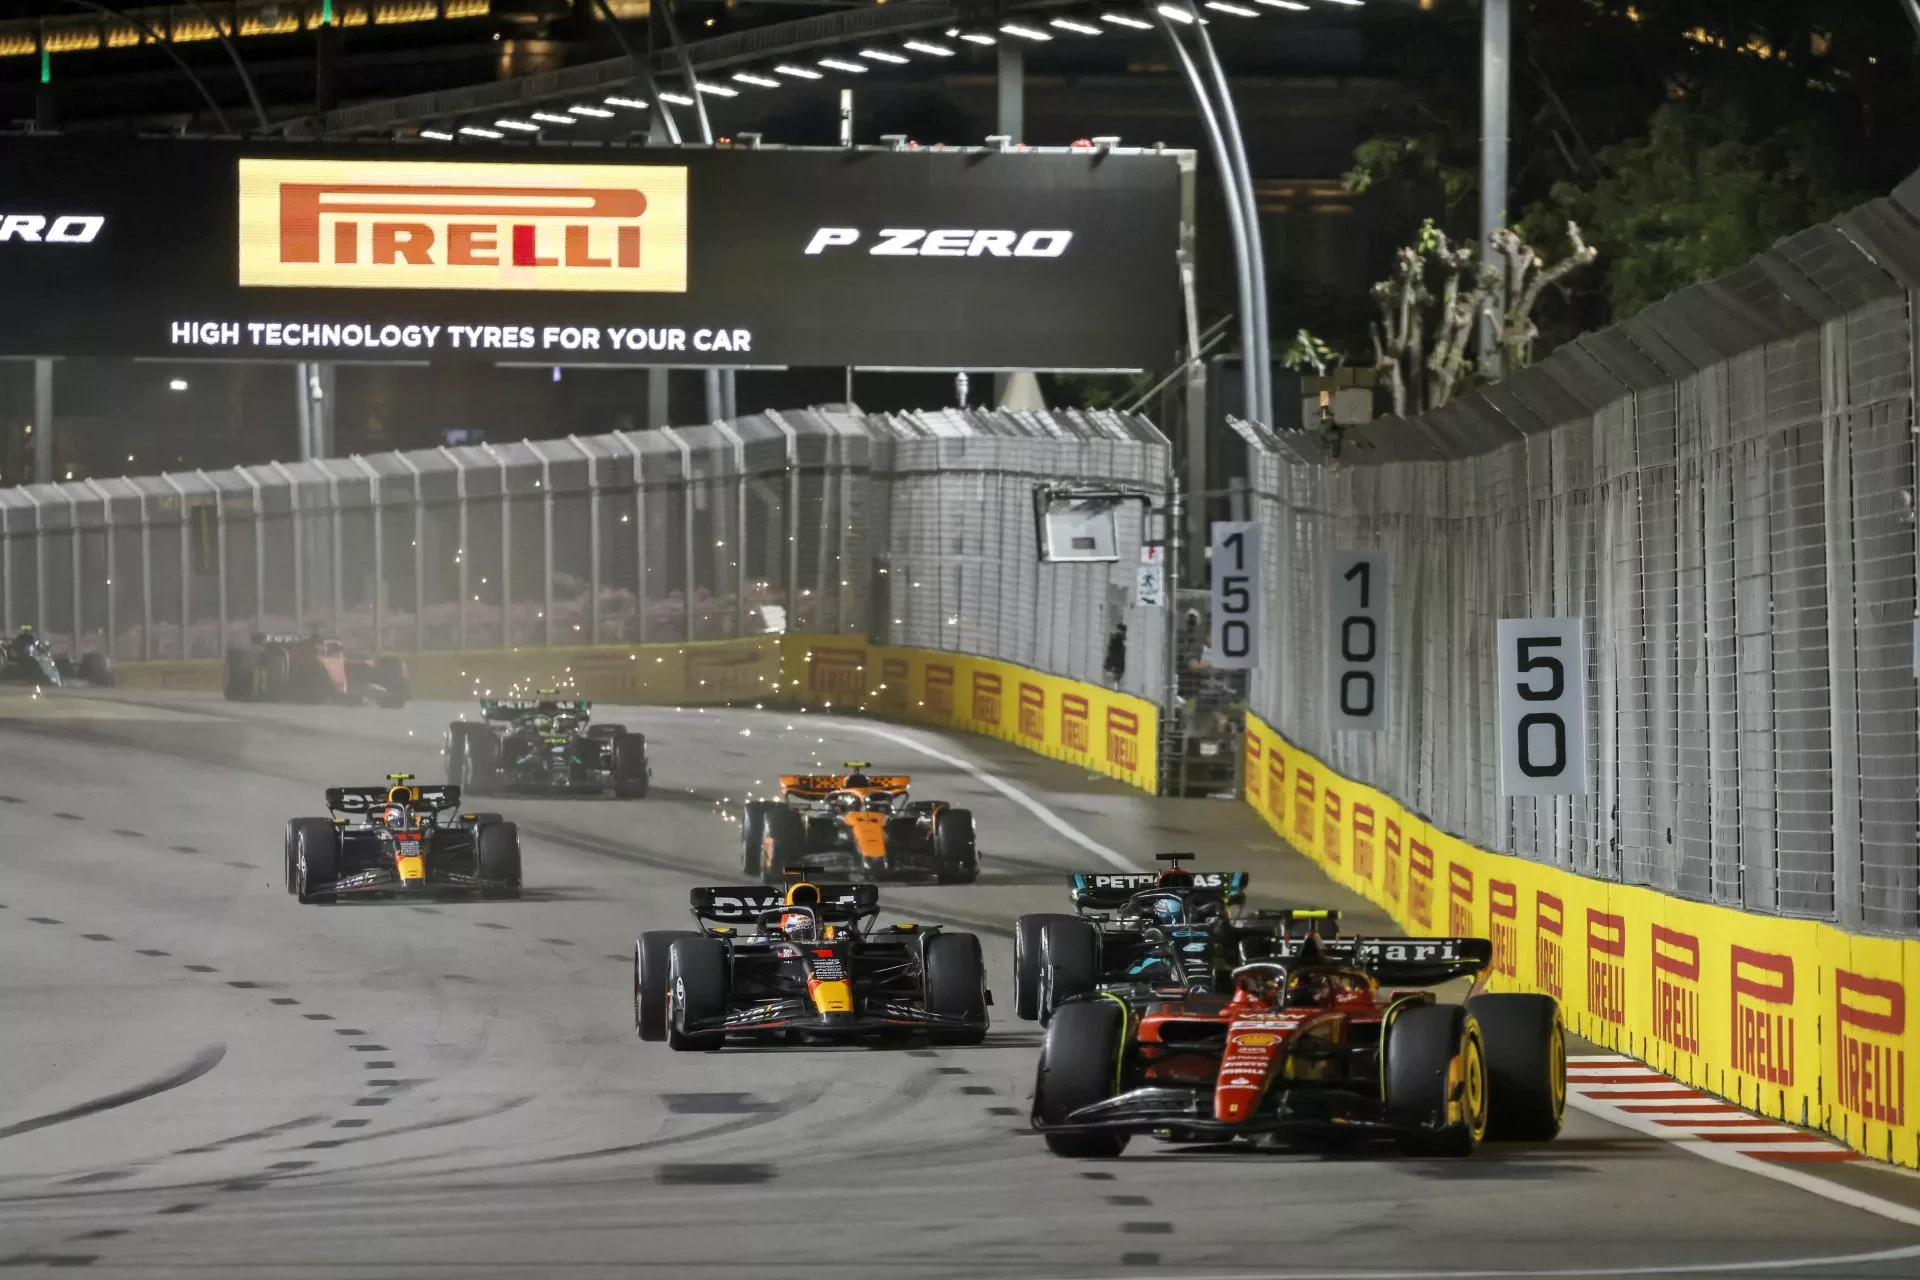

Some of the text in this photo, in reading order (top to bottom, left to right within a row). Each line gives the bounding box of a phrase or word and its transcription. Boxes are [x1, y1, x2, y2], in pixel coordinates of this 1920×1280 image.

[0, 215, 105, 243] RO
[279, 183, 647, 269] PIRELLI
[804, 228, 1073, 258] P ZERO
[171, 322, 751, 351] HIGH TECHNOLOGY TYRES FOR YOUR CAR
[1106, 706, 1139, 771] PIRELLI
[1095, 873, 1222, 890] PETRAS
[1536, 890, 1564, 1000] PIRELLI
[1587, 908, 1626, 1026] PIRELLI
[1651, 923, 1700, 1057] PIRELLI
[1730, 944, 1795, 1087] PIRELLI
[1835, 968, 1906, 1126] PIRELLI
